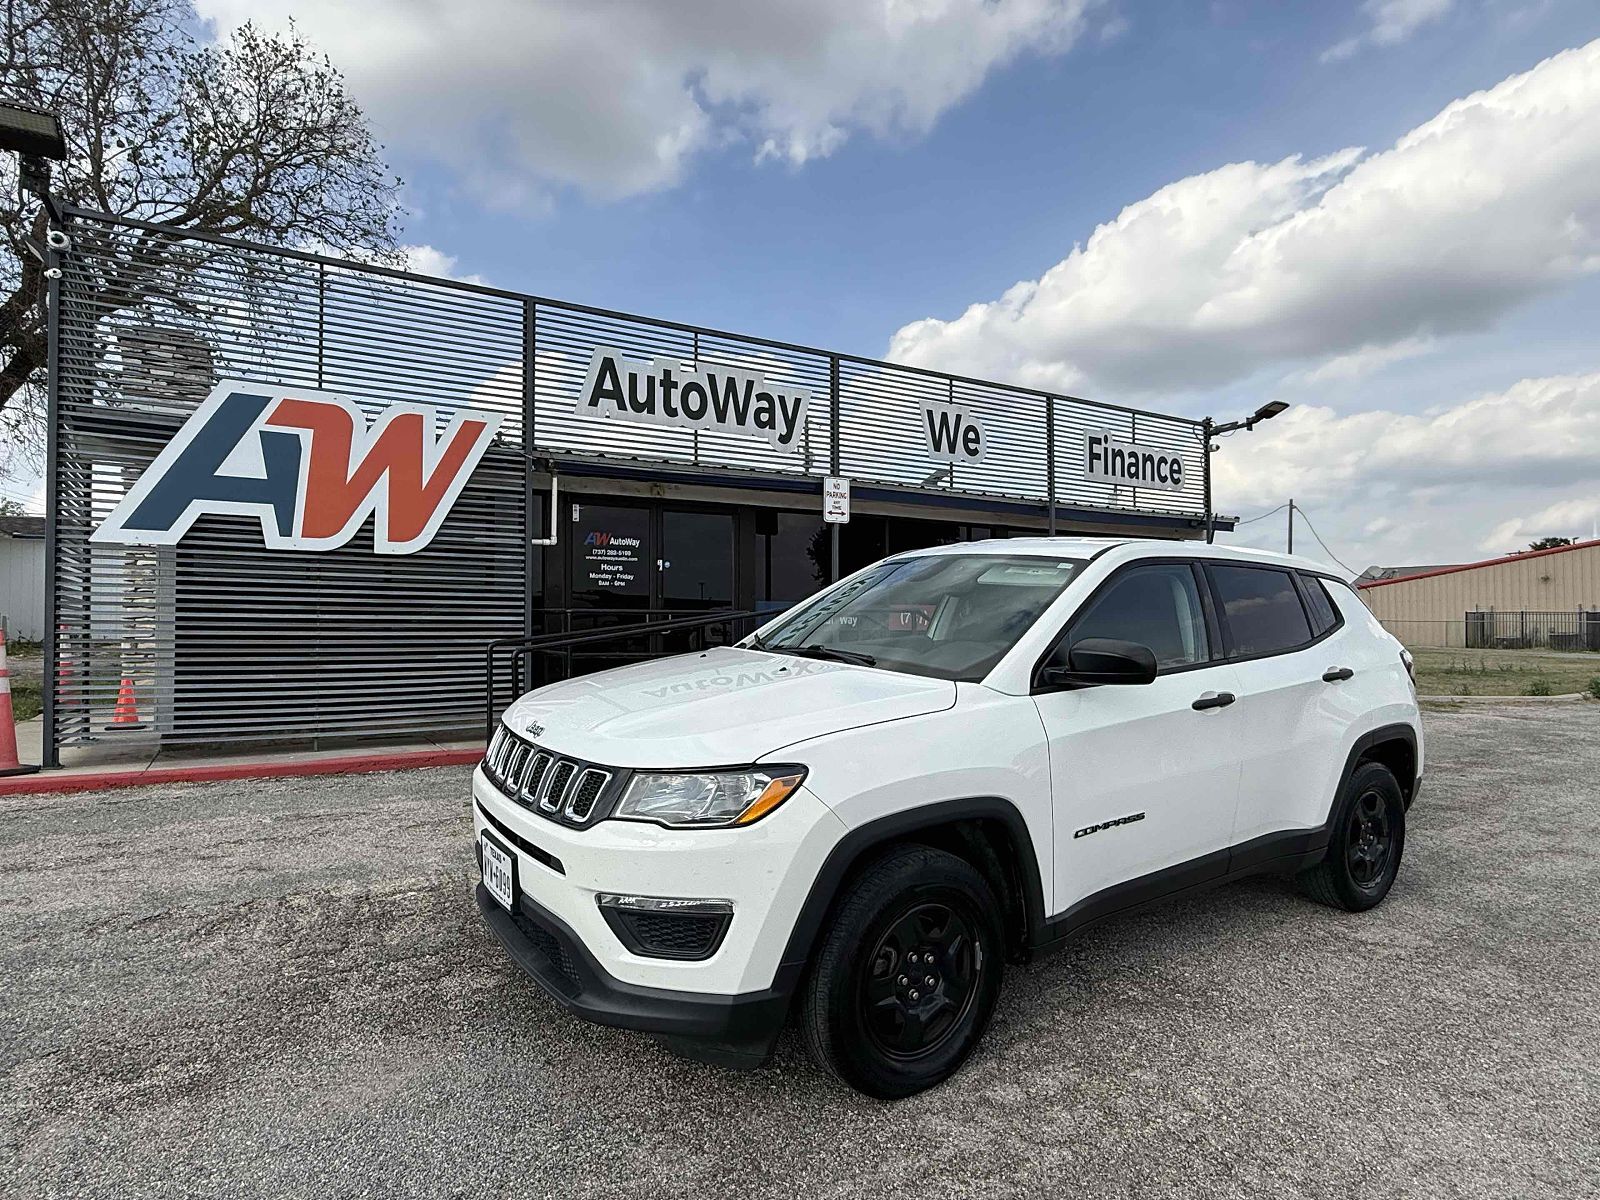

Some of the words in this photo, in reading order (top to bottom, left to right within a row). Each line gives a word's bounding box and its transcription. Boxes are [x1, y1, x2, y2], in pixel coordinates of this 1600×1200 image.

[588, 356, 802, 445] AutoWay
[926, 409, 981, 457] We
[1088, 435, 1182, 486] Finance
[120, 392, 488, 543] AW
[826, 491, 847, 499] PARKING
[609, 537, 640, 548] AutoWay
[526, 720, 545, 739] Jeep
[1073, 812, 1146, 839] COMPASS
